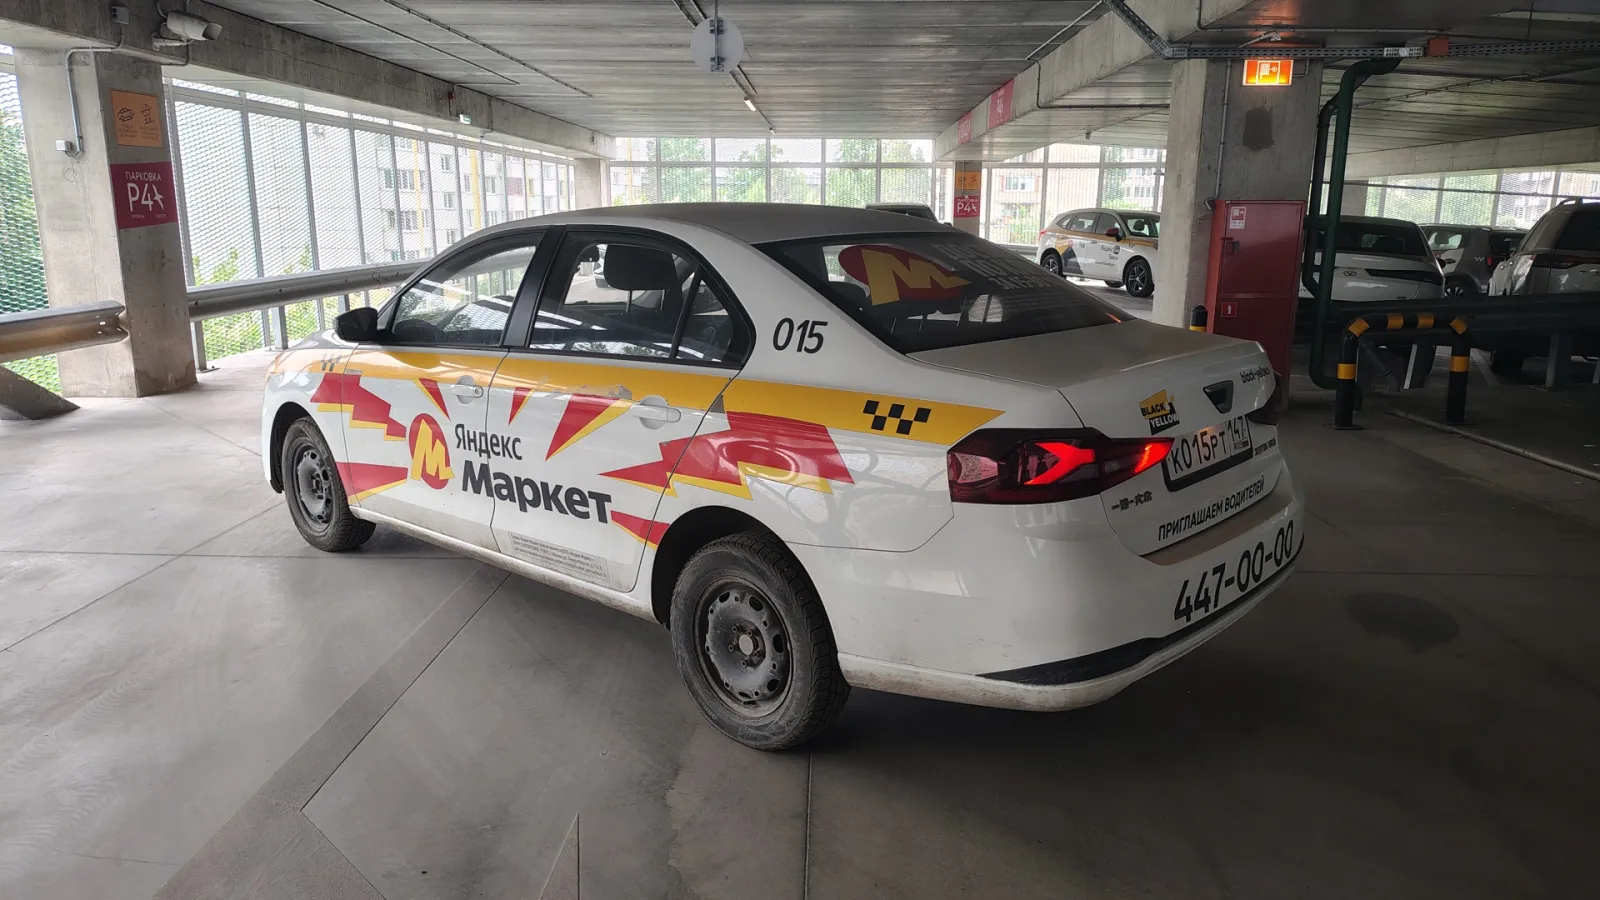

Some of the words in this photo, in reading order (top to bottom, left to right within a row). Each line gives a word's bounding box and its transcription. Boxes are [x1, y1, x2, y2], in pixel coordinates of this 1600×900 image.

[125, 171, 162, 182] ПАРКОВКА
[772, 317, 829, 354] 015
[1140, 402, 1168, 417] BLACK
[1150, 413, 1180, 428] YELLOW
[454, 423, 523, 461] Яндекс
[461, 460, 612, 524] Маркет
[1158, 501, 1223, 541] ПРИГЛАШАЕМ
[1224, 475, 1265, 513] ВОДИТЕЛЕЙ
[1173, 519, 1295, 623] 447-00-00
